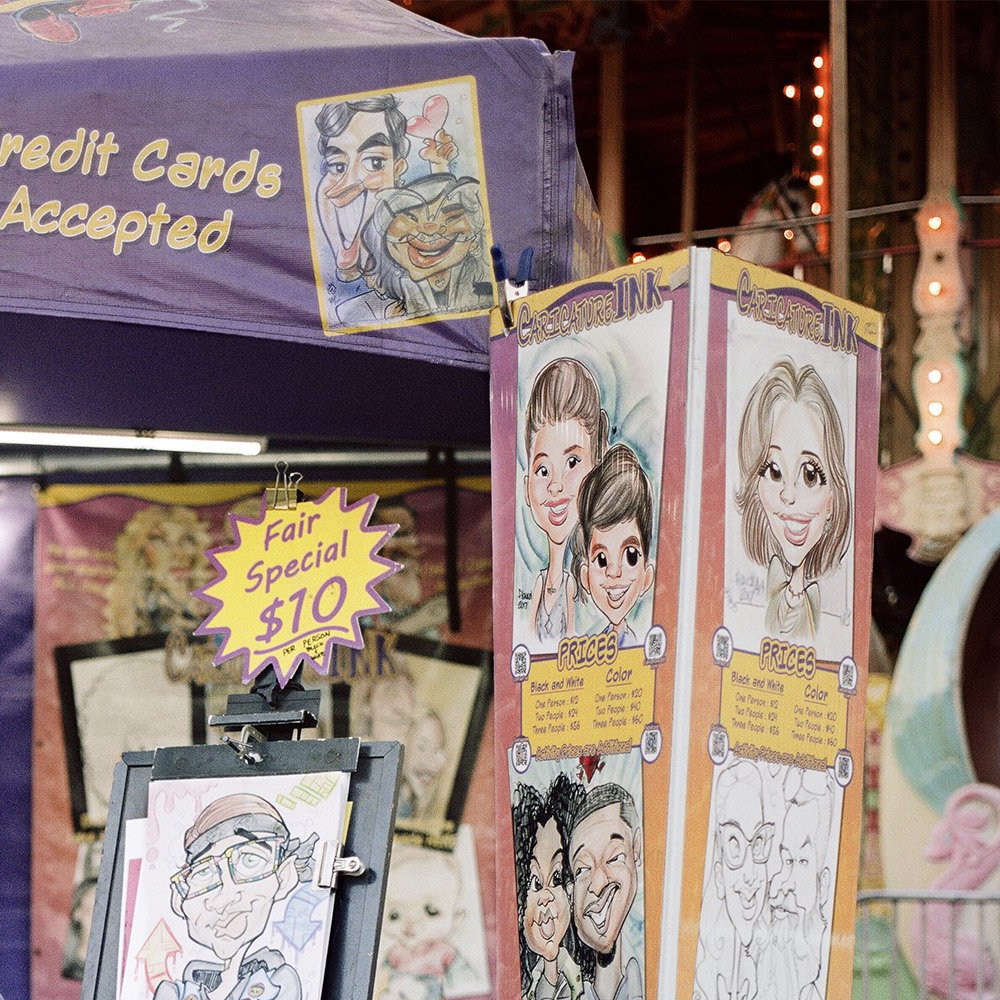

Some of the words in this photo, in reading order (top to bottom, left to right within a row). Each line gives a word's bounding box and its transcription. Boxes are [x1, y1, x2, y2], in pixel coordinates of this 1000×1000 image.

[132, 138, 282, 198] Cards
[264, 512, 320, 551] Fair
[245, 529, 348, 594] Special
[255, 576, 347, 643] $10
[303, 630, 330, 648] PERSON
[559, 632, 617, 669] PRICES
[606, 667, 633, 683] Color
[760, 639, 815, 678] PRICES
[530, 681, 549, 693] Black
[552, 679, 564, 690] and
[566, 676, 584, 688] White
[731, 671, 750, 686] Black
[752, 677, 766, 688] and
[767, 679, 784, 693] White
[805, 684, 828, 702] Color
